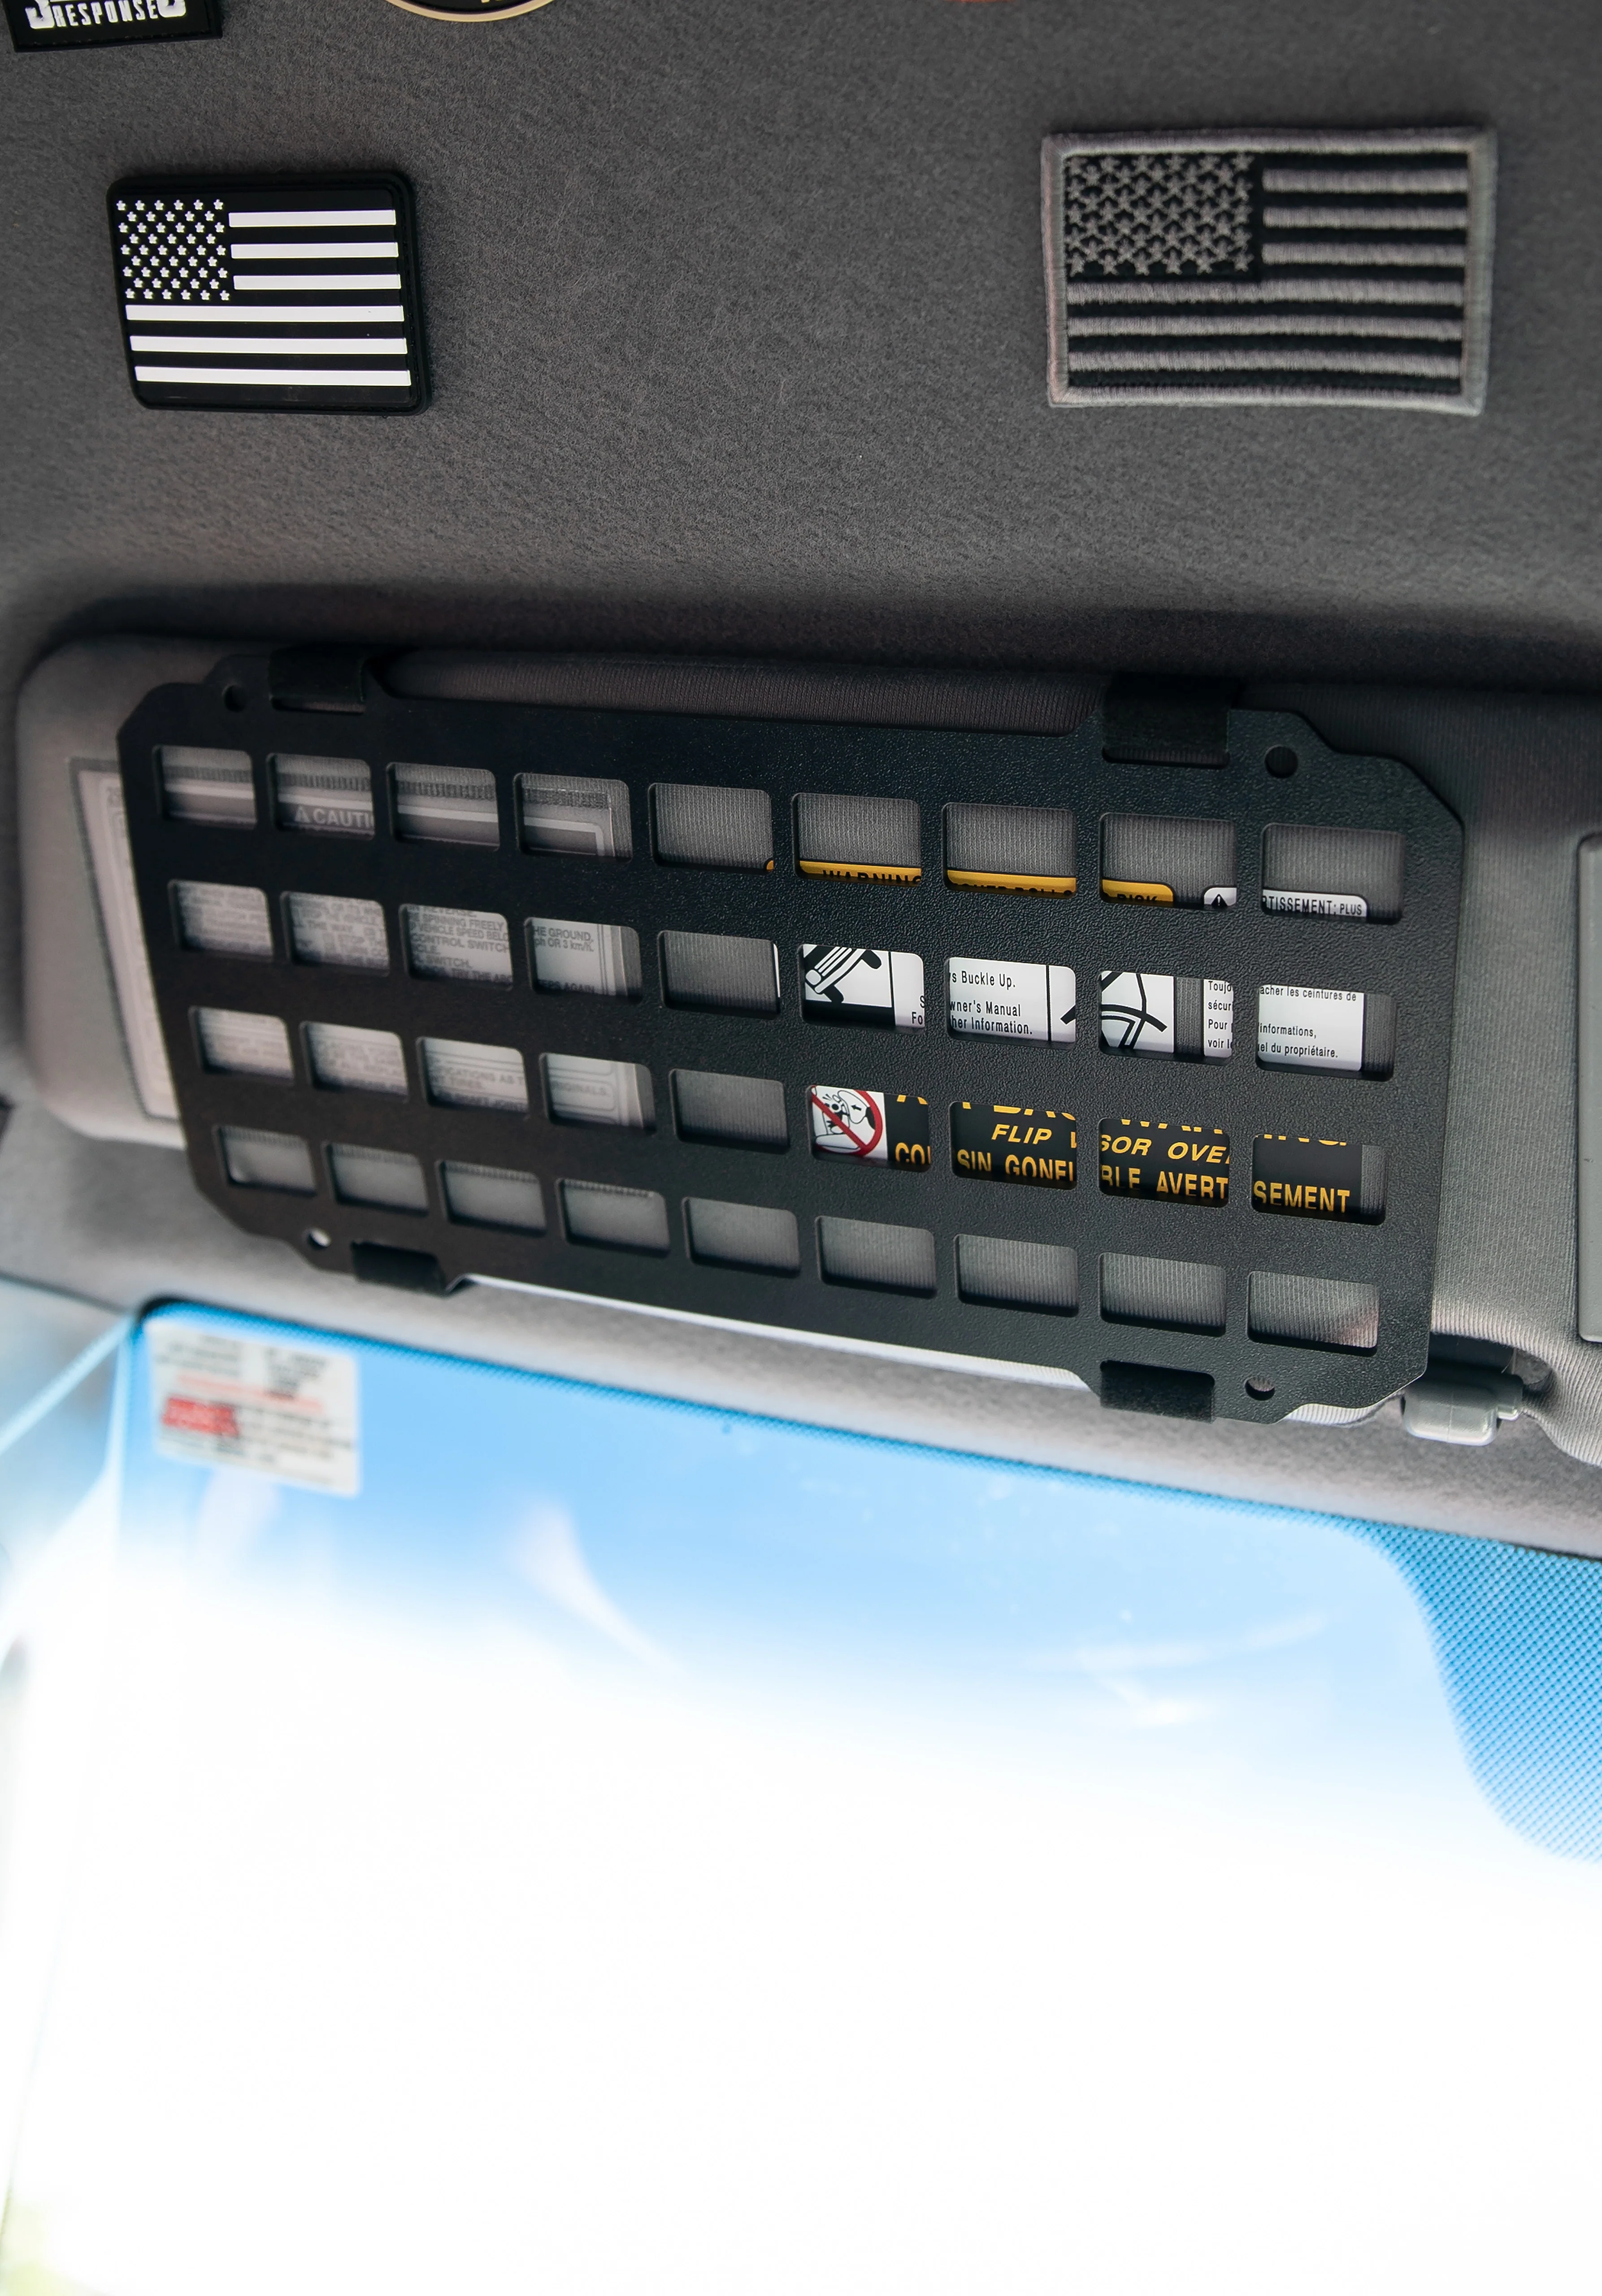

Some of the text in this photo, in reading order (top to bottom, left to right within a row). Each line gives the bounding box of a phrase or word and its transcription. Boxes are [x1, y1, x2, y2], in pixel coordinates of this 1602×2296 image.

[52, 0, 158, 27] RESPONSE
[313, 808, 374, 828] CAUTI
[1340, 903, 1362, 915] PLUS
[456, 927, 484, 939] SPEED
[469, 919, 505, 931] FREELY
[548, 927, 594, 942] GROUND.
[961, 970, 995, 986] Buckle
[999, 973, 1016, 990] Up.
[1287, 986, 1299, 997] les
[1302, 989, 1343, 1000] ceintures
[1346, 991, 1357, 1001] de
[986, 1000, 1021, 1017] Manual
[911, 1011, 924, 1025] Fo
[971, 1016, 1033, 1035] Information.
[1208, 1018, 1228, 1030] Pour
[1207, 1038, 1224, 1048] voir
[1271, 1043, 1281, 1053] du
[1285, 1045, 1338, 1058] propriétaire.
[991, 1124, 1052, 1144] FLIP
[1168, 1142, 1230, 1164] OVE
[895, 1142, 931, 1165] CO
[957, 1149, 992, 1172] SIN
[1156, 1170, 1229, 1200] AVERT
[1253, 1180, 1350, 1213] SEMENT
